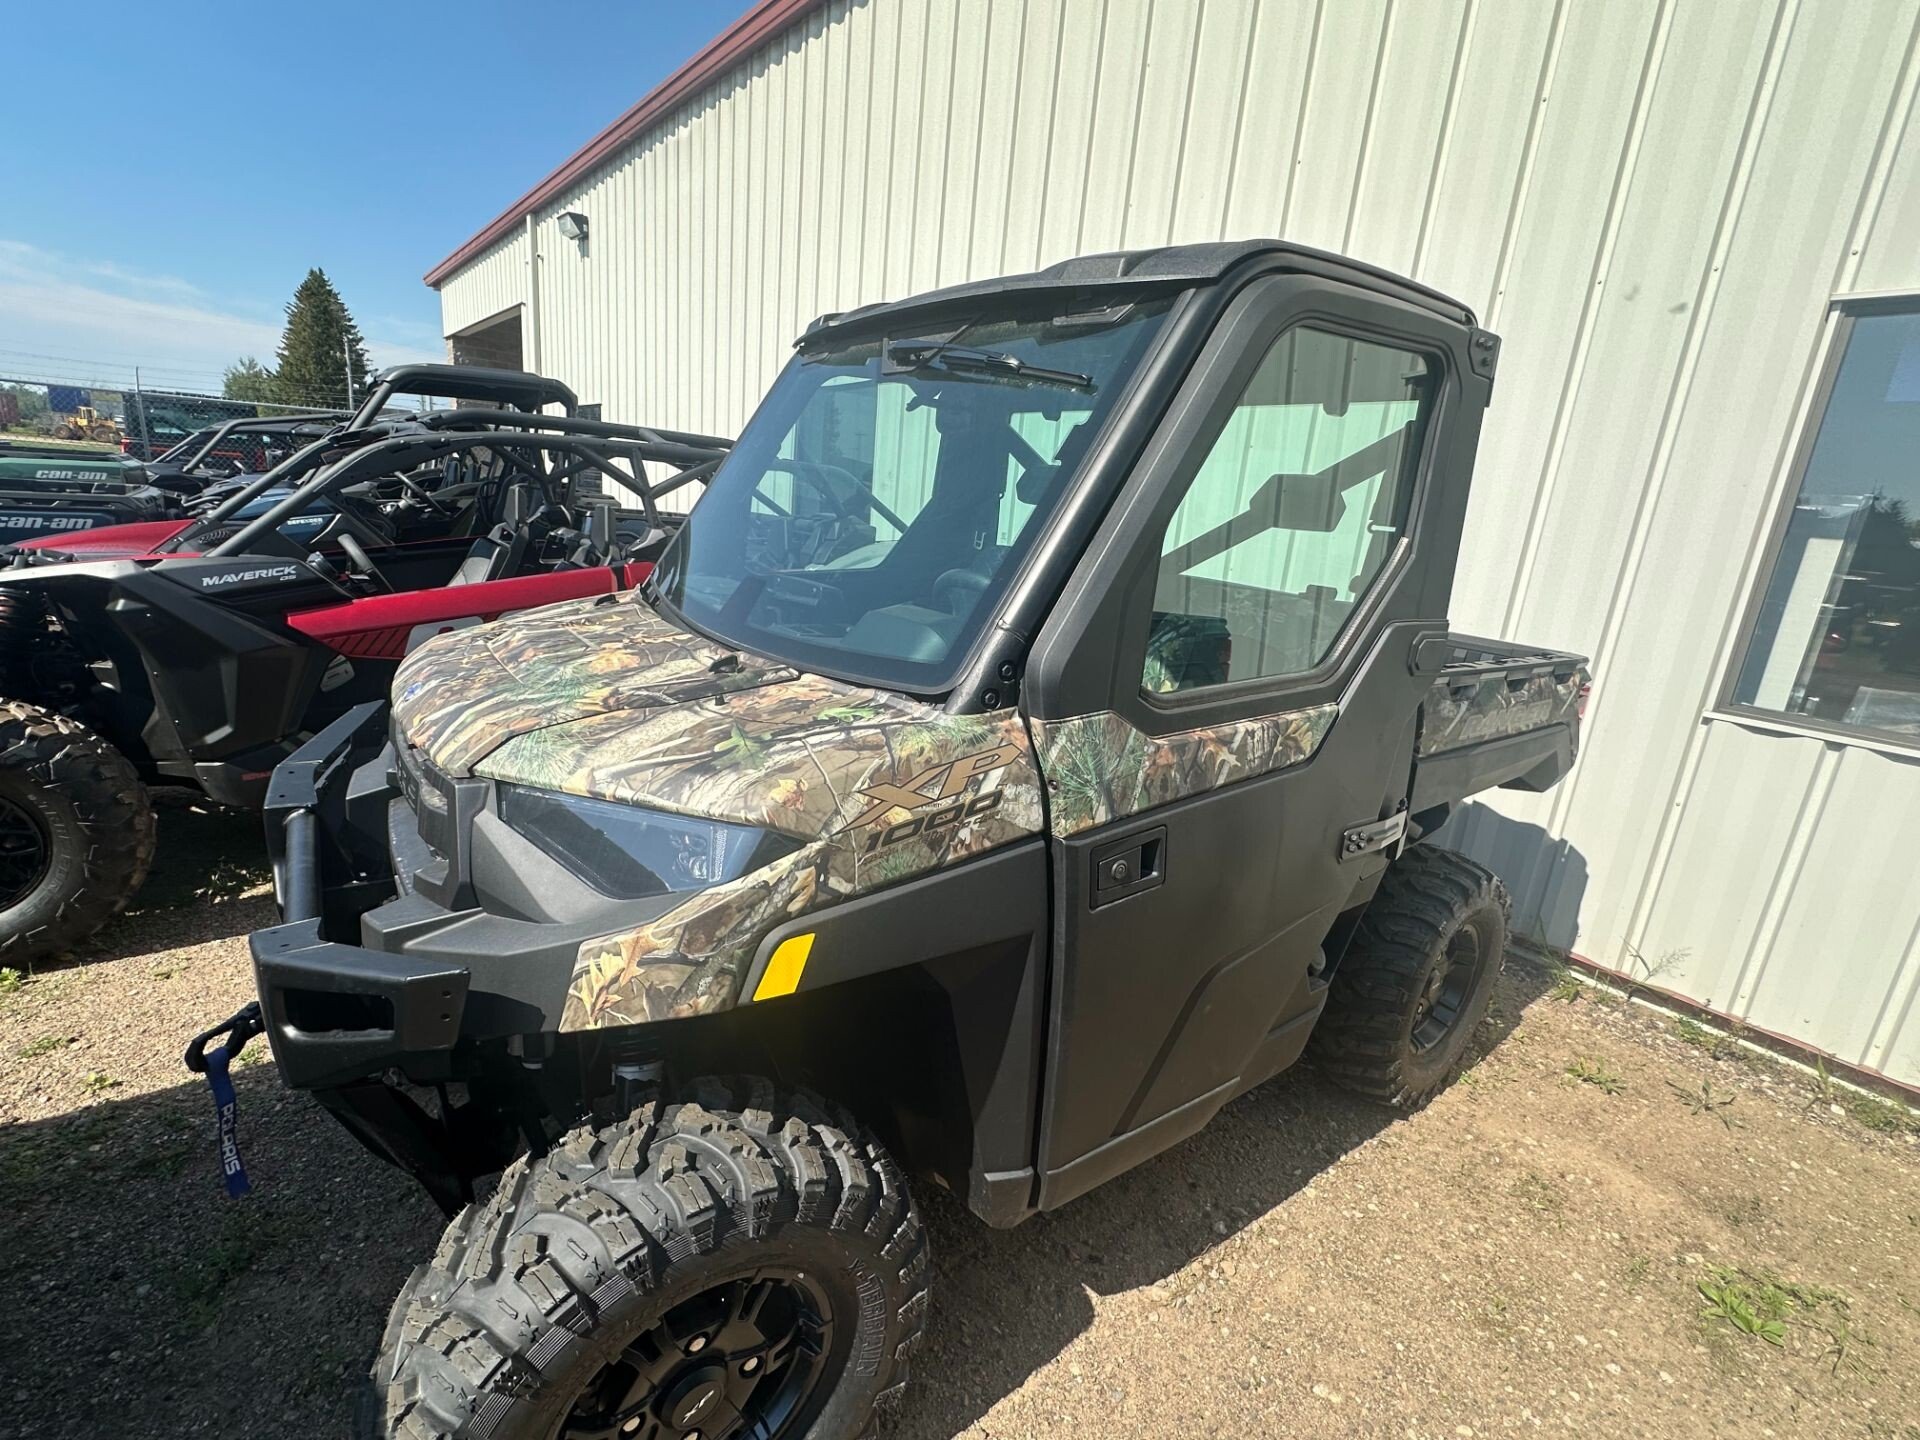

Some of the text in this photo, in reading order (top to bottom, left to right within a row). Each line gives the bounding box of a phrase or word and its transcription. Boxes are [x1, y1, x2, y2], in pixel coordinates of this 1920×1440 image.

[35, 470, 107, 480] can-am
[202, 565, 297, 586] MAVERICK
[831, 743, 1022, 836] XP
[865, 789, 1003, 852] 1000
[220, 1102, 241, 1175] POLARIS
